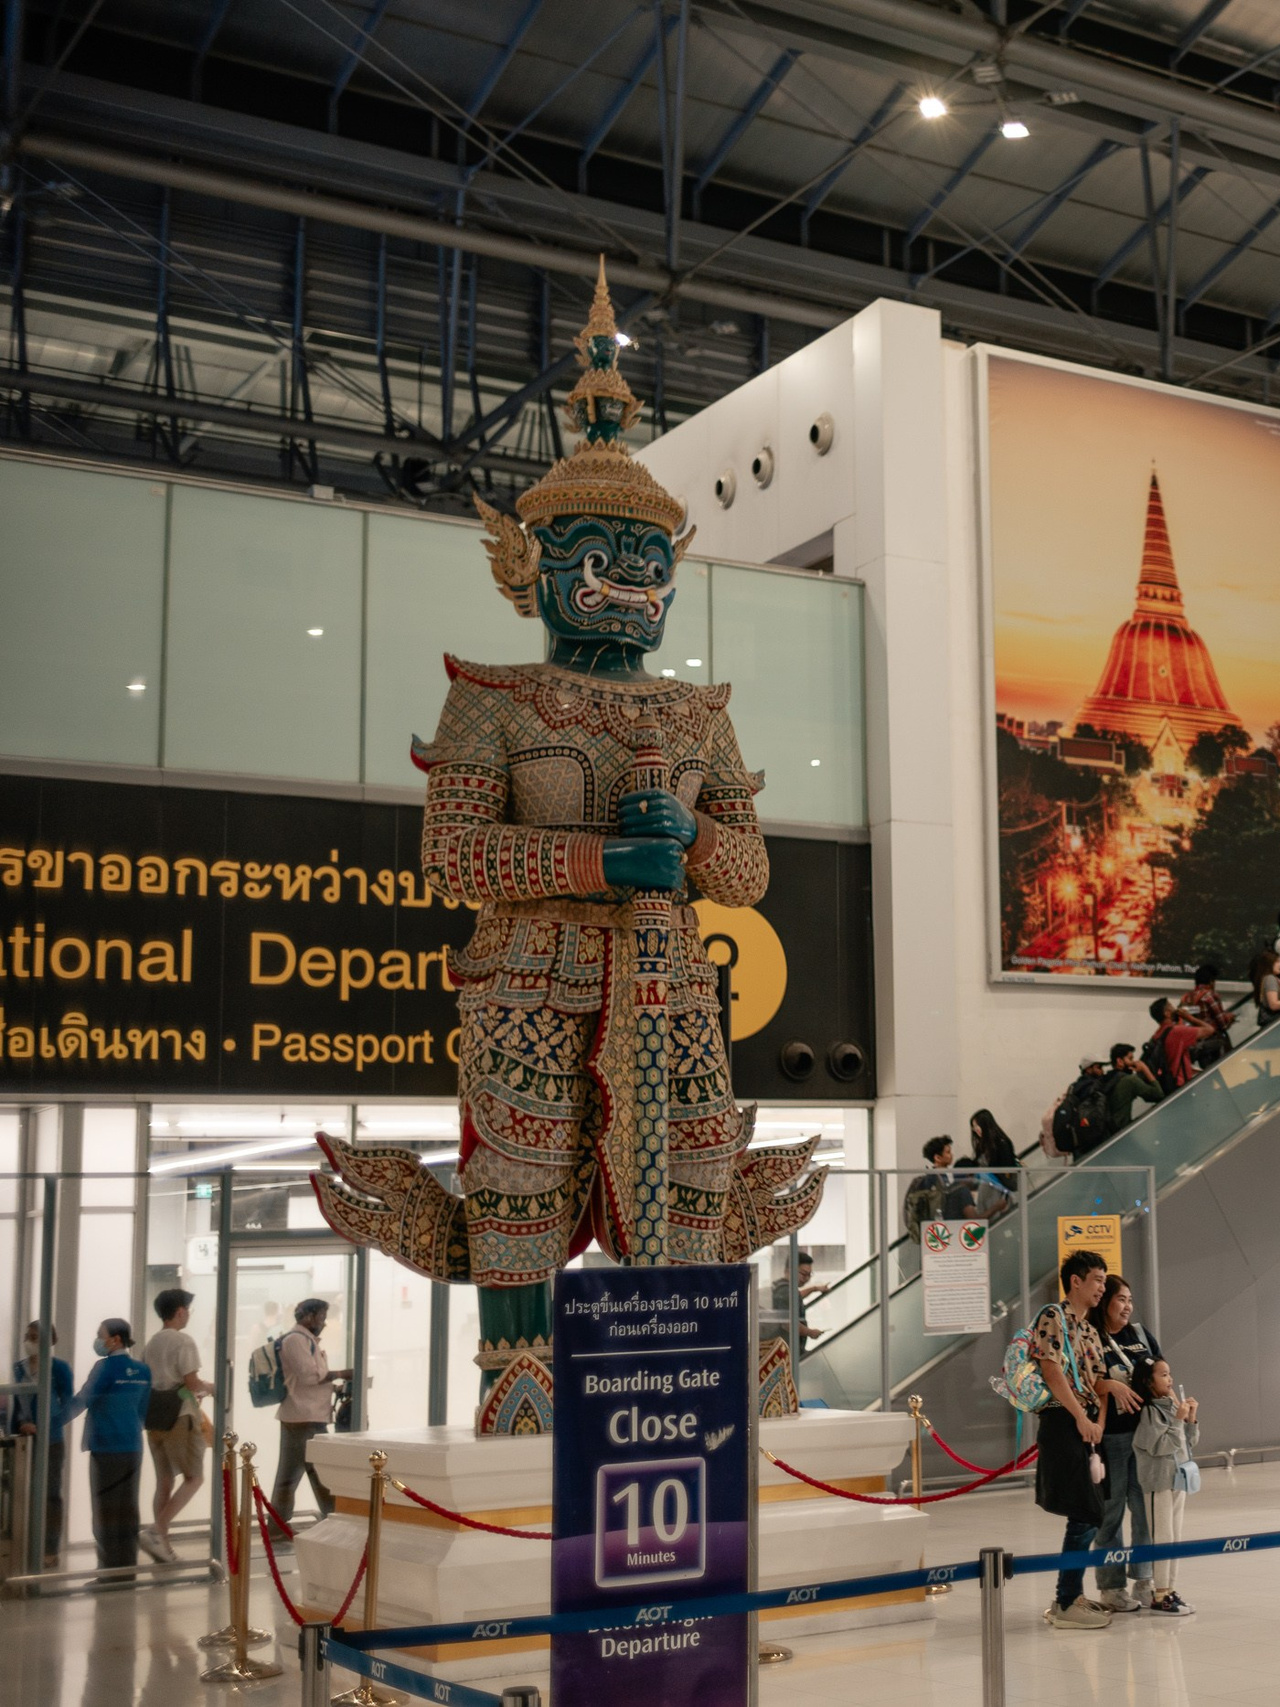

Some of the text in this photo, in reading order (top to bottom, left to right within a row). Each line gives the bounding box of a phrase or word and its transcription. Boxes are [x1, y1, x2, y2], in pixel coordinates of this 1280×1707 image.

[0, 922, 193, 983] tional
[0, 1007, 206, 1061] อเดินทาง
[252, 1023, 434, 1072] Passport
[1087, 1225, 1111, 1234] CCTV
[565, 1291, 738, 1320] ประตูขึ้นเครื่องจะปิด 10 นาที
[609, 1314, 698, 1337] ก่อนเครื่องออก
[585, 1369, 720, 1394] Boarding Gate
[609, 1406, 698, 1445] Close
[612, 1479, 689, 1547] 10
[1222, 1538, 1250, 1552] AOT
[626, 1551, 676, 1567] Minutes
[1104, 1549, 1133, 1563] AOT
[927, 1566, 957, 1582] AOT
[787, 1587, 820, 1603] AOT
[635, 1605, 673, 1622] AOT
[472, 1621, 512, 1638] AOT
[601, 1631, 700, 1660] Departure
[370, 1661, 386, 1678] AOT
[434, 1683, 451, 1702] AOT
